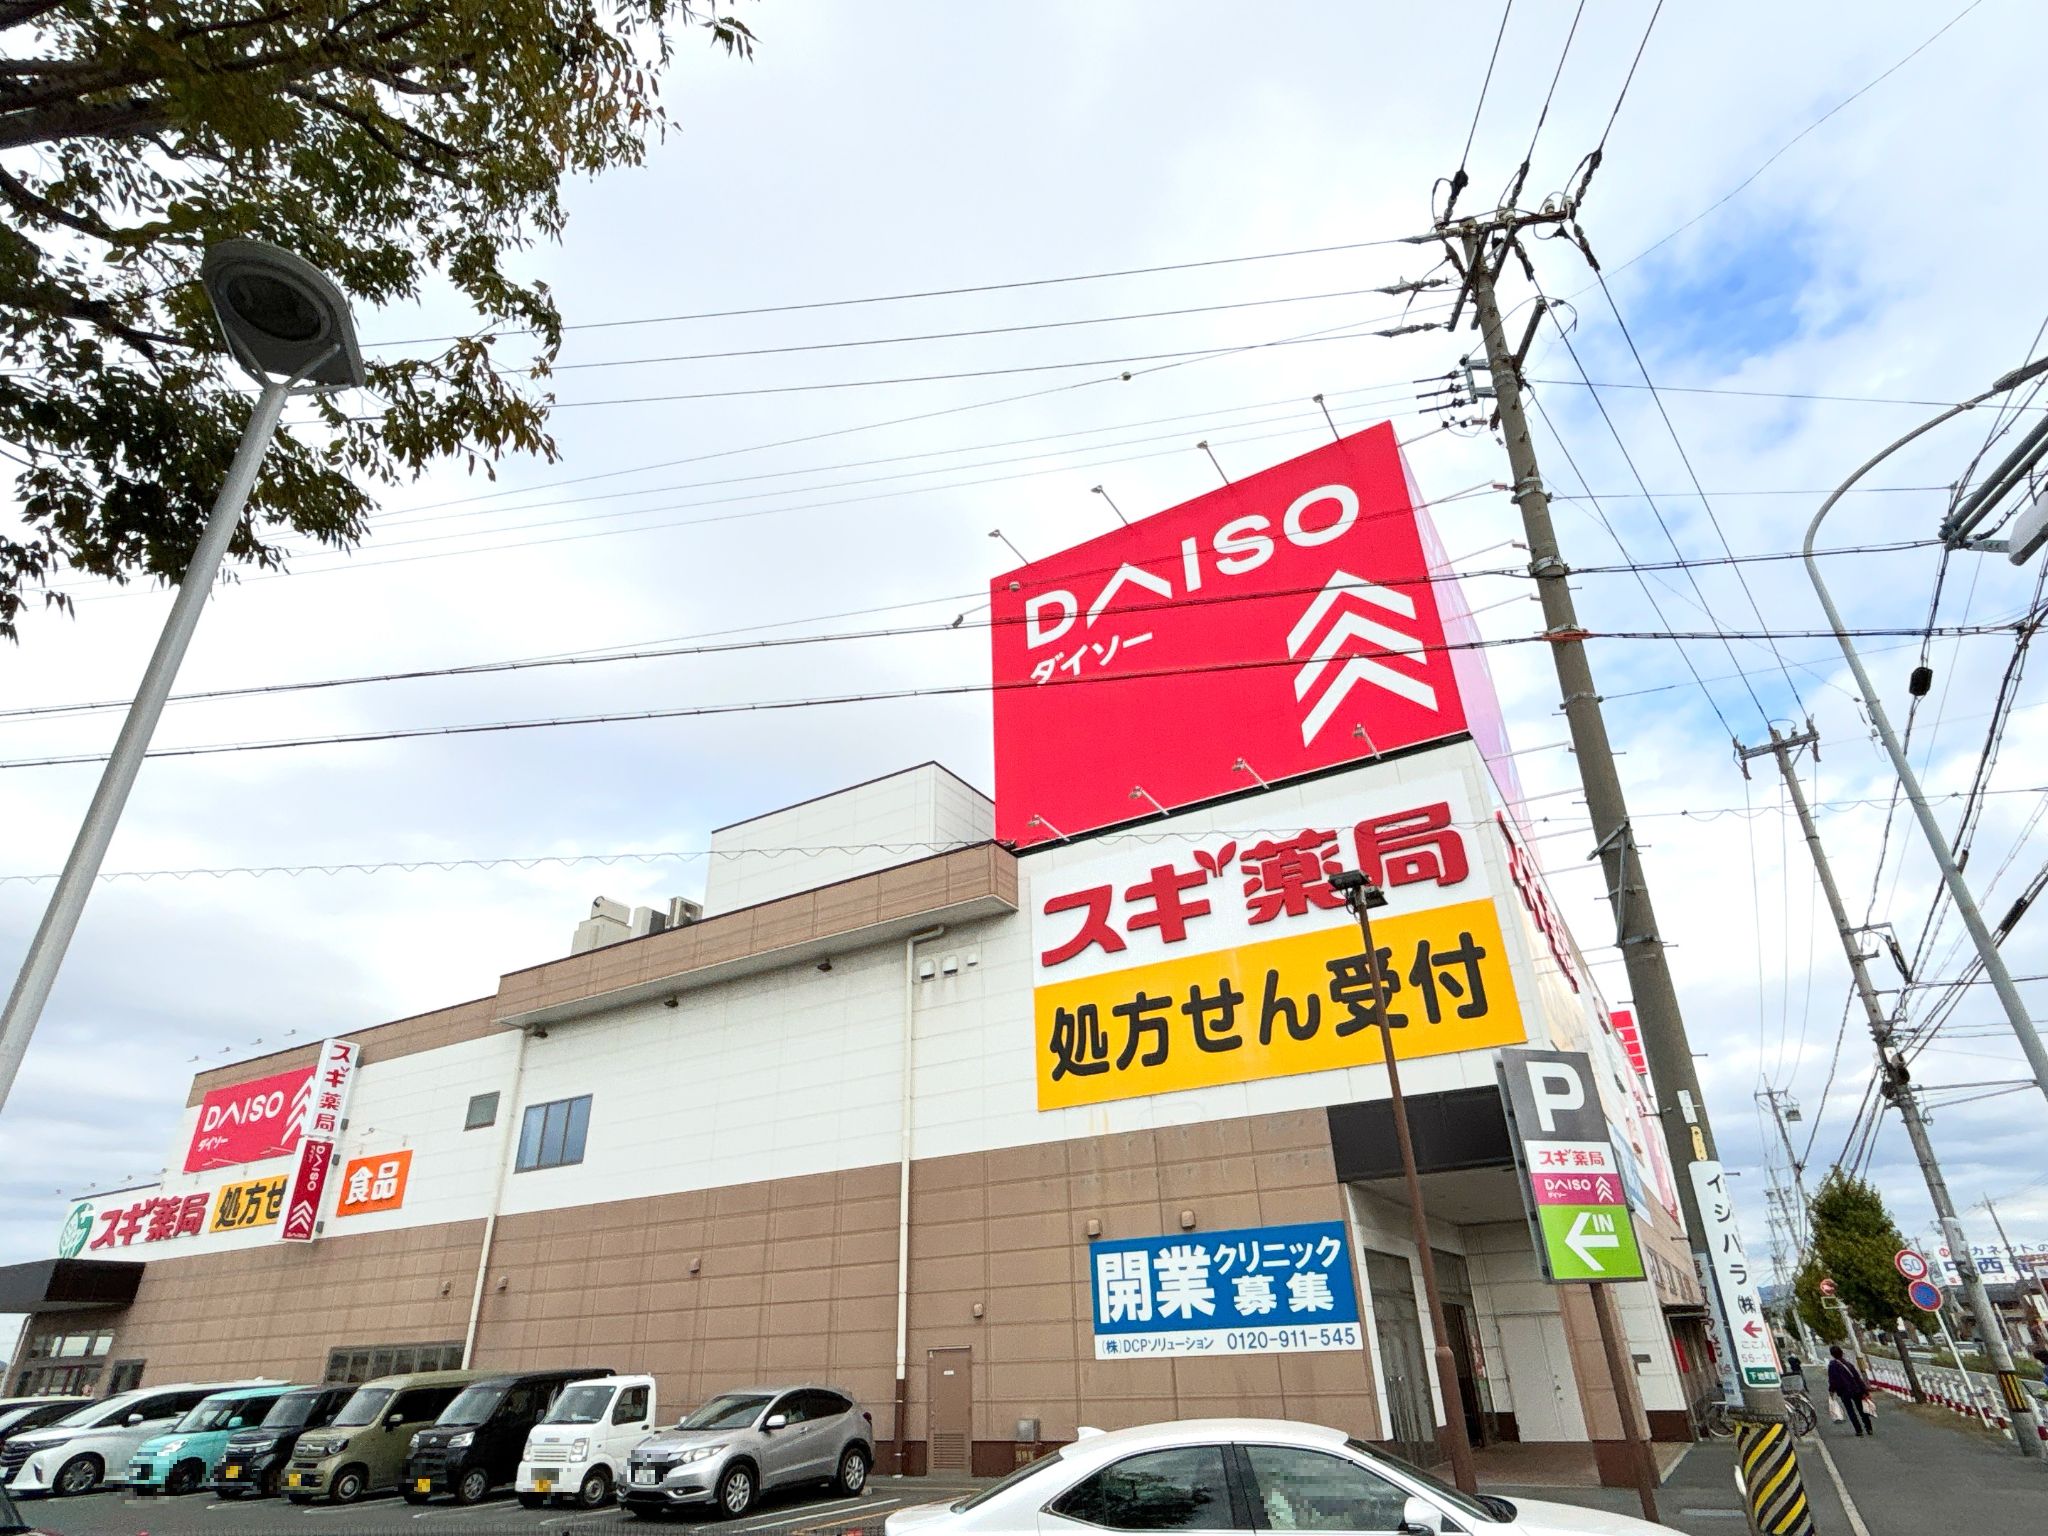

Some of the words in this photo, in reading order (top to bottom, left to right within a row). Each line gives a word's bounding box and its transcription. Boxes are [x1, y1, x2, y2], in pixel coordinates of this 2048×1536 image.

[1025, 484, 1360, 650] DAISO
[1030, 632, 1153, 686] ダイソー
[1041, 801, 1470, 968] スギ薬局
[1048, 931, 1489, 1082] 処方せん受付
[314, 1045, 351, 1132] スギ薬局
[1525, 1060, 1585, 1132] P
[202, 1091, 284, 1133] DAISO
[198, 1135, 229, 1152] ダイソー
[1538, 1150, 1604, 1166] スギ薬局
[216, 1179, 287, 1229] 処方せ
[345, 1161, 399, 1205] 食品
[1544, 1179, 1592, 1191] DAISO
[90, 1193, 210, 1250] スギ薬局
[1592, 1213, 1615, 1233] IN
[1213, 1236, 1341, 1275] クリニック
[1903, 1258, 1921, 1272] 50
[1097, 1245, 1216, 1324] 開業
[1231, 1271, 1334, 1316] 募集
[1102, 1336, 1214, 1355] (株)DCPソリューション
[1227, 1328, 1356, 1350] 0120-911-545
